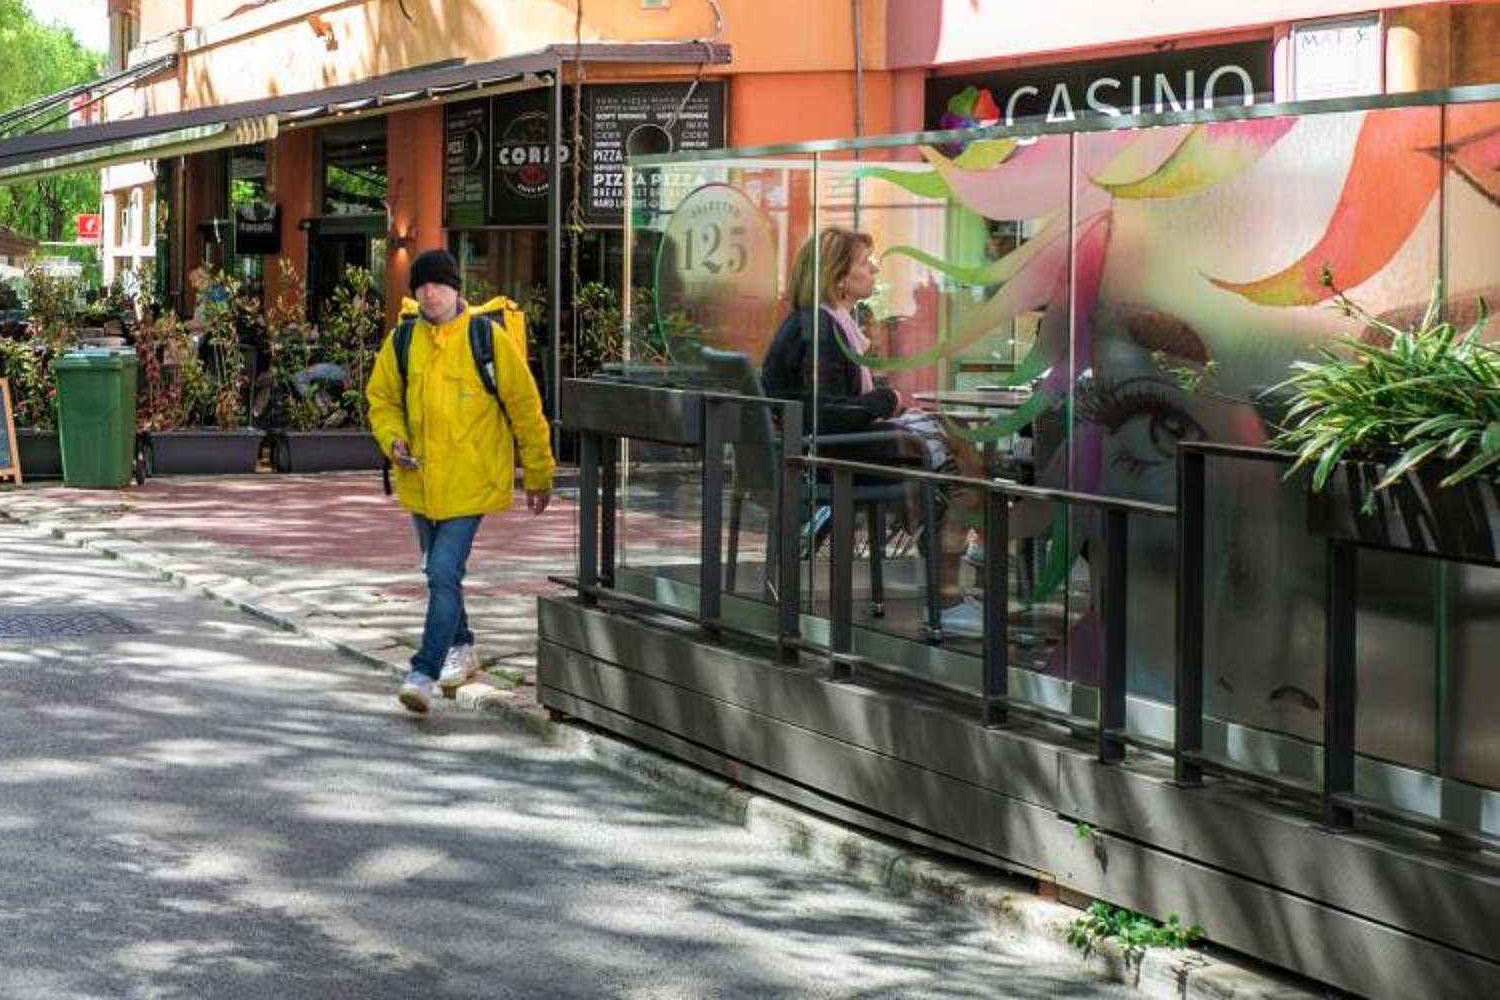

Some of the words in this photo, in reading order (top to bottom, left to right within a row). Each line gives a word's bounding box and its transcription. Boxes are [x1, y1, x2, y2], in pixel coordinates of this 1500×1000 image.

[1005, 64, 1255, 144] CASINO
[593, 149, 623, 162] PIZZA
[593, 173, 646, 186] PIZA
[677, 223, 748, 274] 125
